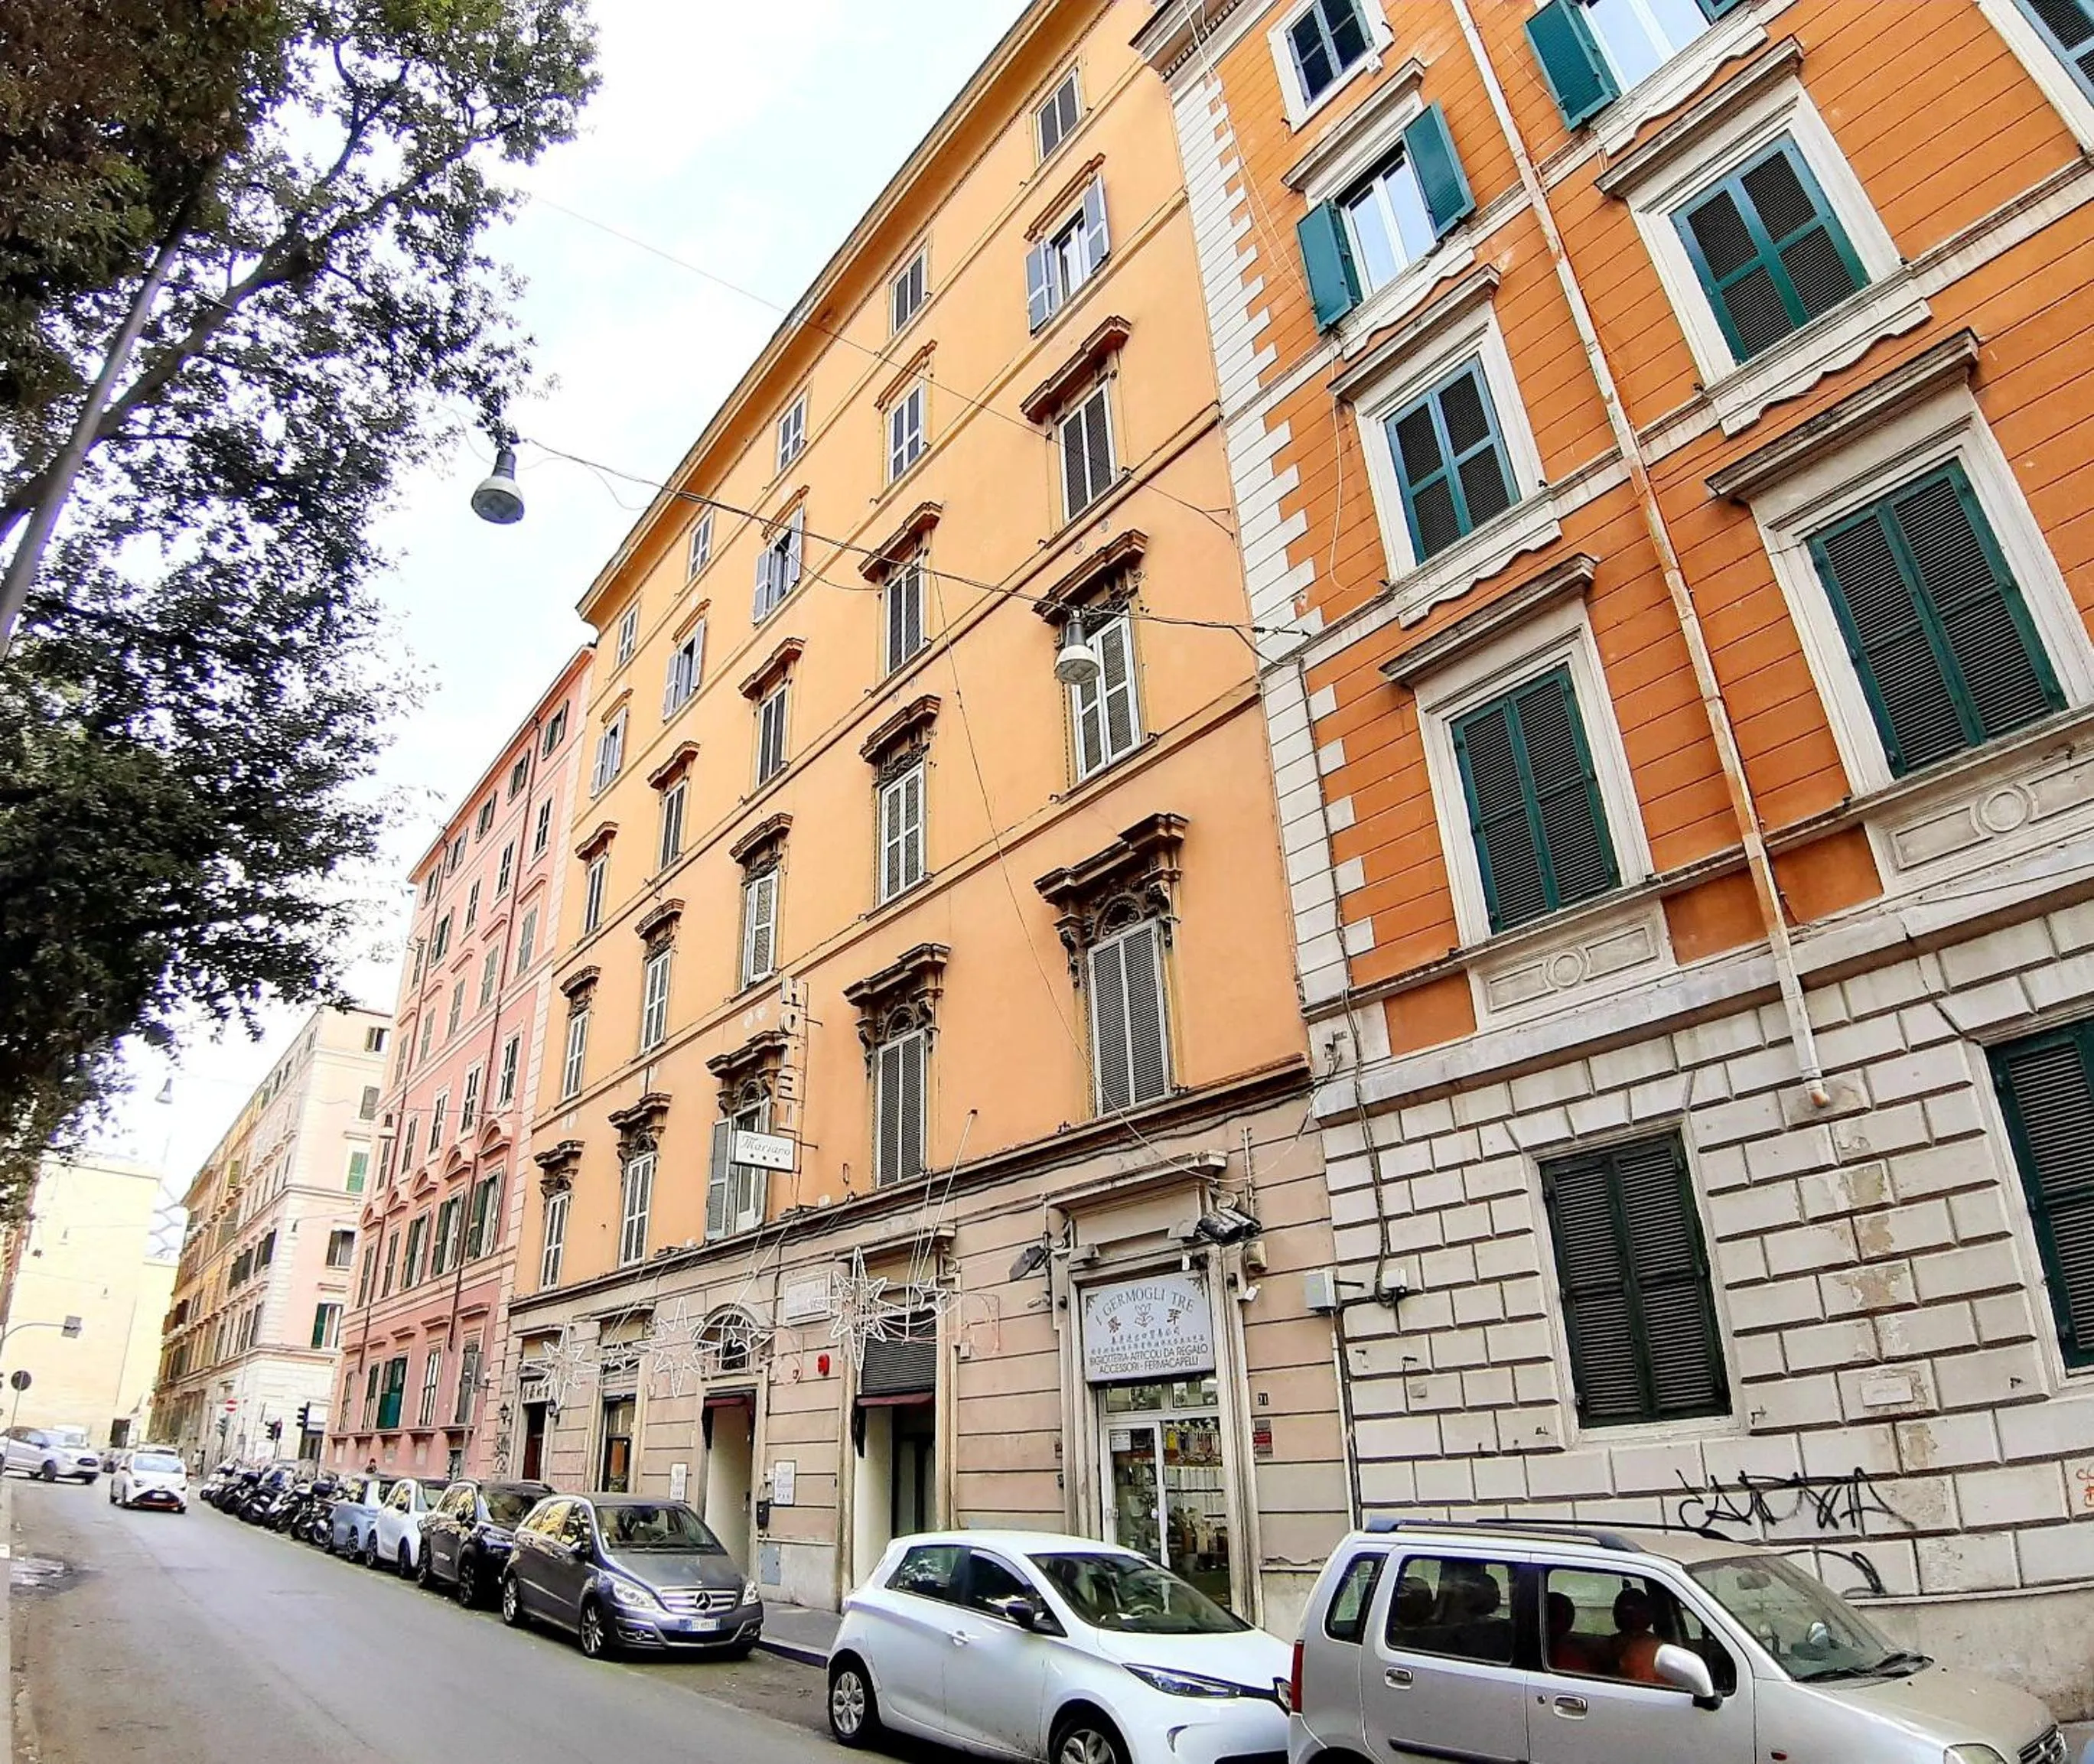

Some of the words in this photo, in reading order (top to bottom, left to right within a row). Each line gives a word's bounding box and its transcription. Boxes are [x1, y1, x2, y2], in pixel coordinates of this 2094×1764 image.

[1102, 1287, 1164, 1316] GERMOGLI
[1172, 1291, 1195, 1313] TRE
[1164, 1346, 1175, 1357] DA
[1177, 1343, 1209, 1356] REGALO
[1099, 1362, 1139, 1374] ACCESSORI
[1144, 1356, 1199, 1372] FERMACAPELLI
